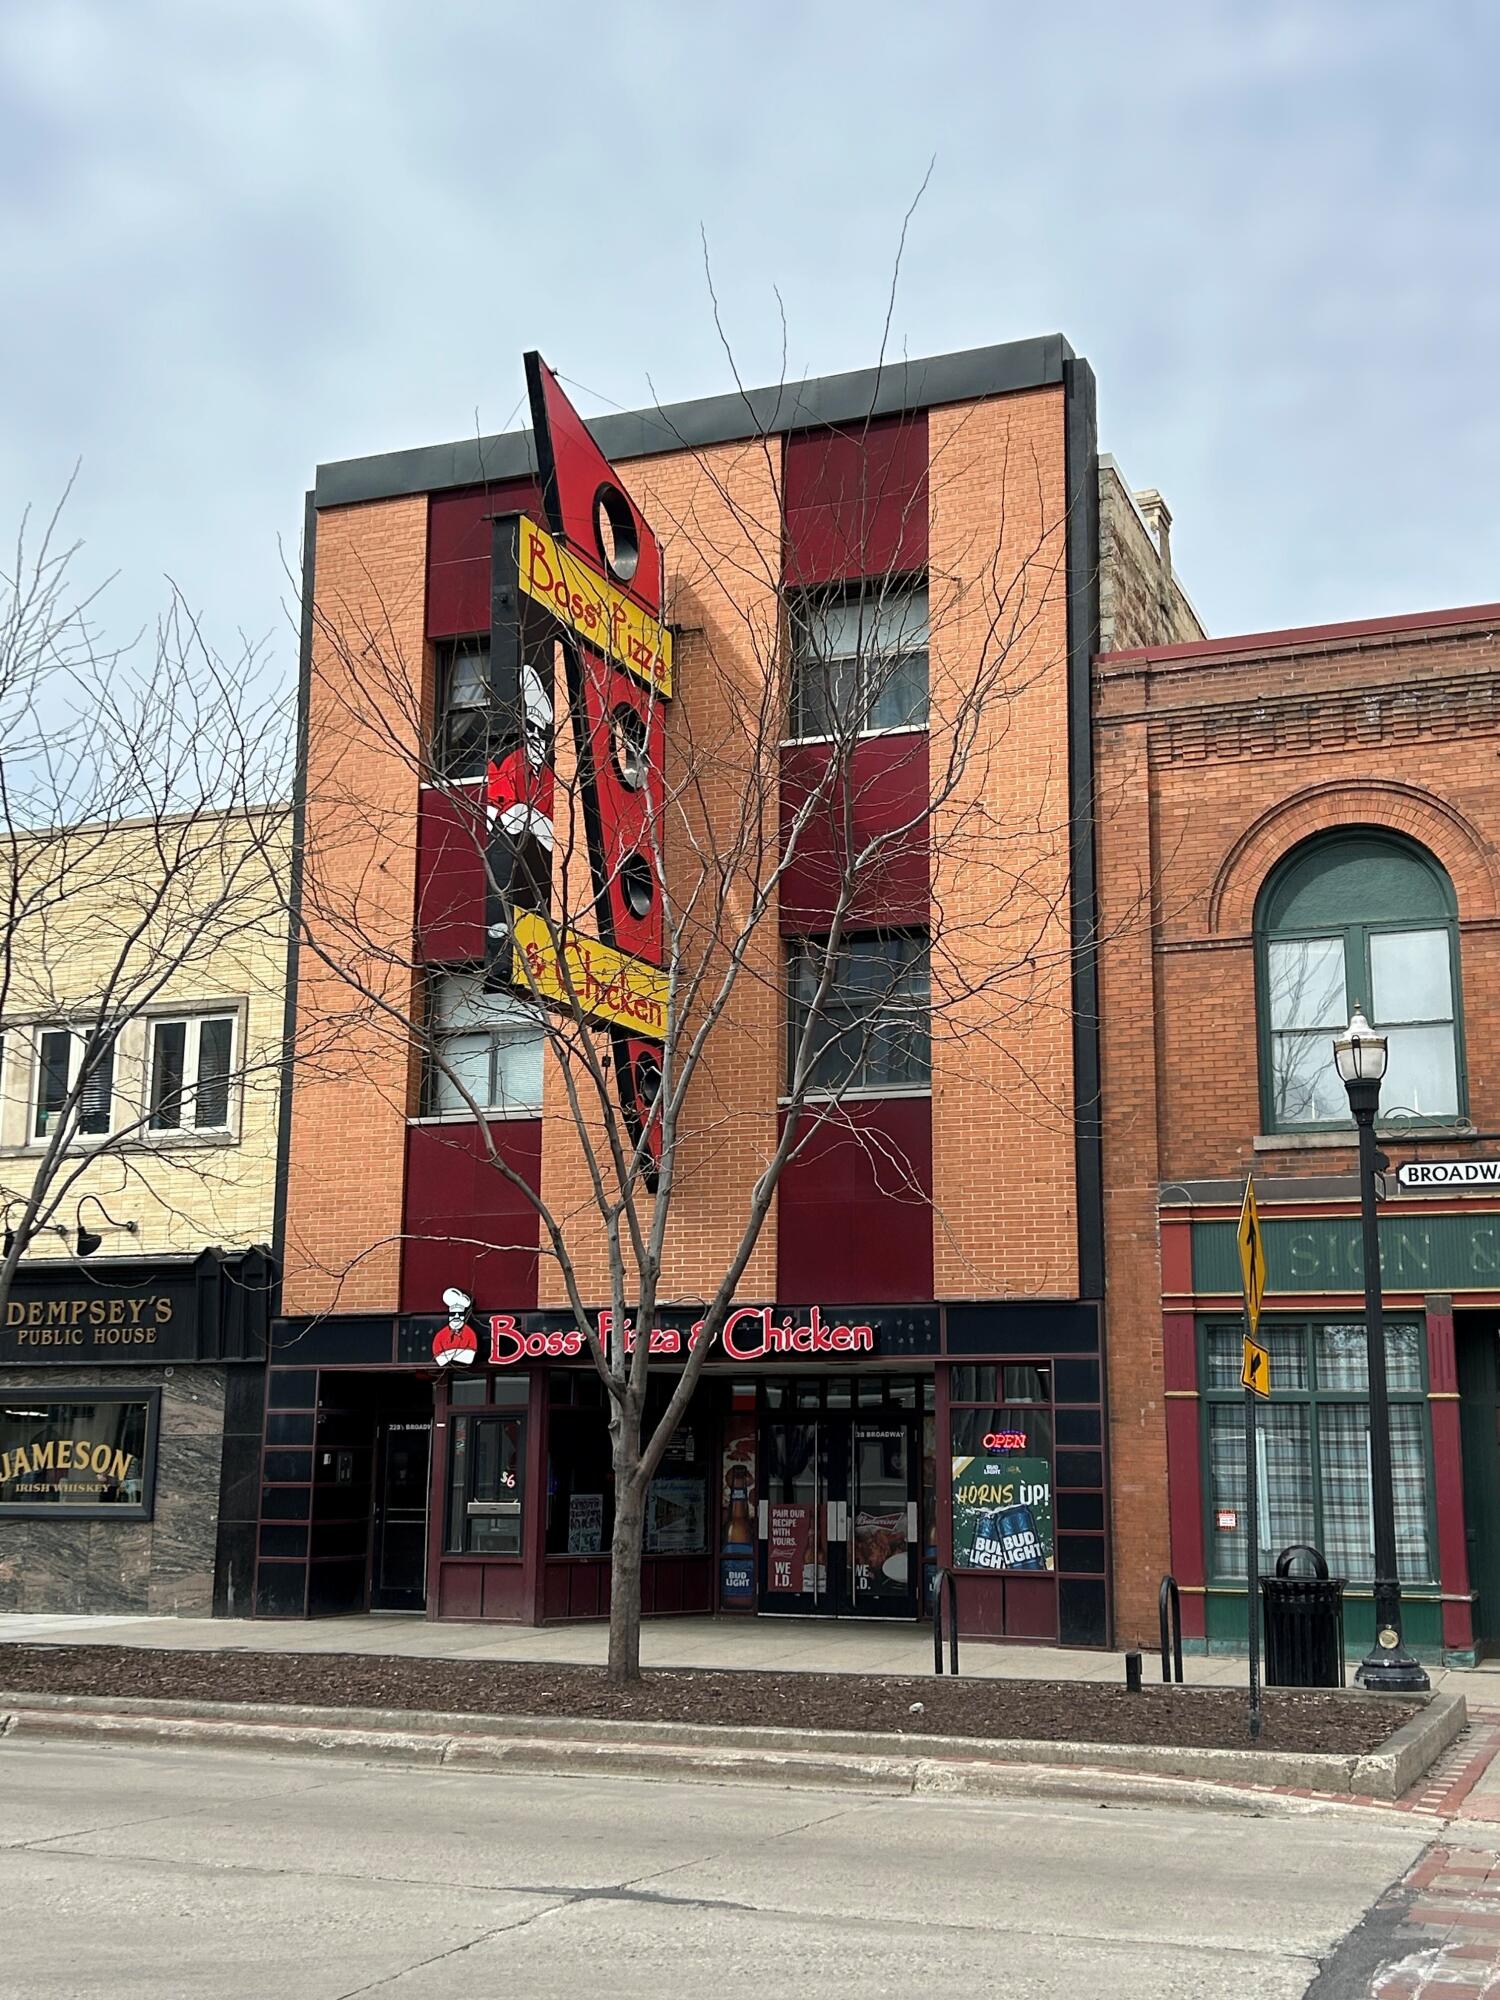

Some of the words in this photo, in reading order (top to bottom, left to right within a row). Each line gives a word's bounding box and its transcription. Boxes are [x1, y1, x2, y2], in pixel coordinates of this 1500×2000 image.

[612, 601, 667, 681] Pizza
[525, 942, 545, 978] &
[555, 942, 662, 1026] Chcken
[1407, 1164, 1500, 1182] BROADW
[5, 1296, 173, 1326] DEMPSEY'S
[17, 1329, 85, 1345] PUBLIC
[93, 1327, 157, 1344] HOUSE
[723, 1305, 874, 1360] Chicken
[983, 1433, 1027, 1449] OPEN
[0, 1440, 134, 1482] JAMESON
[15, 1483, 54, 1493] IRISH
[54, 1483, 111, 1493] WHISKEY
[957, 1482, 1014, 1505] HORNS
[1019, 1481, 1049, 1506] UP!
[772, 1509, 789, 1518] PAIR
[789, 1509, 805, 1518] OUR
[772, 1519, 797, 1528] RECIPE
[772, 1528, 791, 1537] WITH
[1003, 1531, 1035, 1551] BUD
[772, 1537, 797, 1546] YOURS.
[774, 1562, 792, 1575] WE
[726, 1579, 750, 1587] LIGHT
[856, 1577, 872, 1590] .D.
